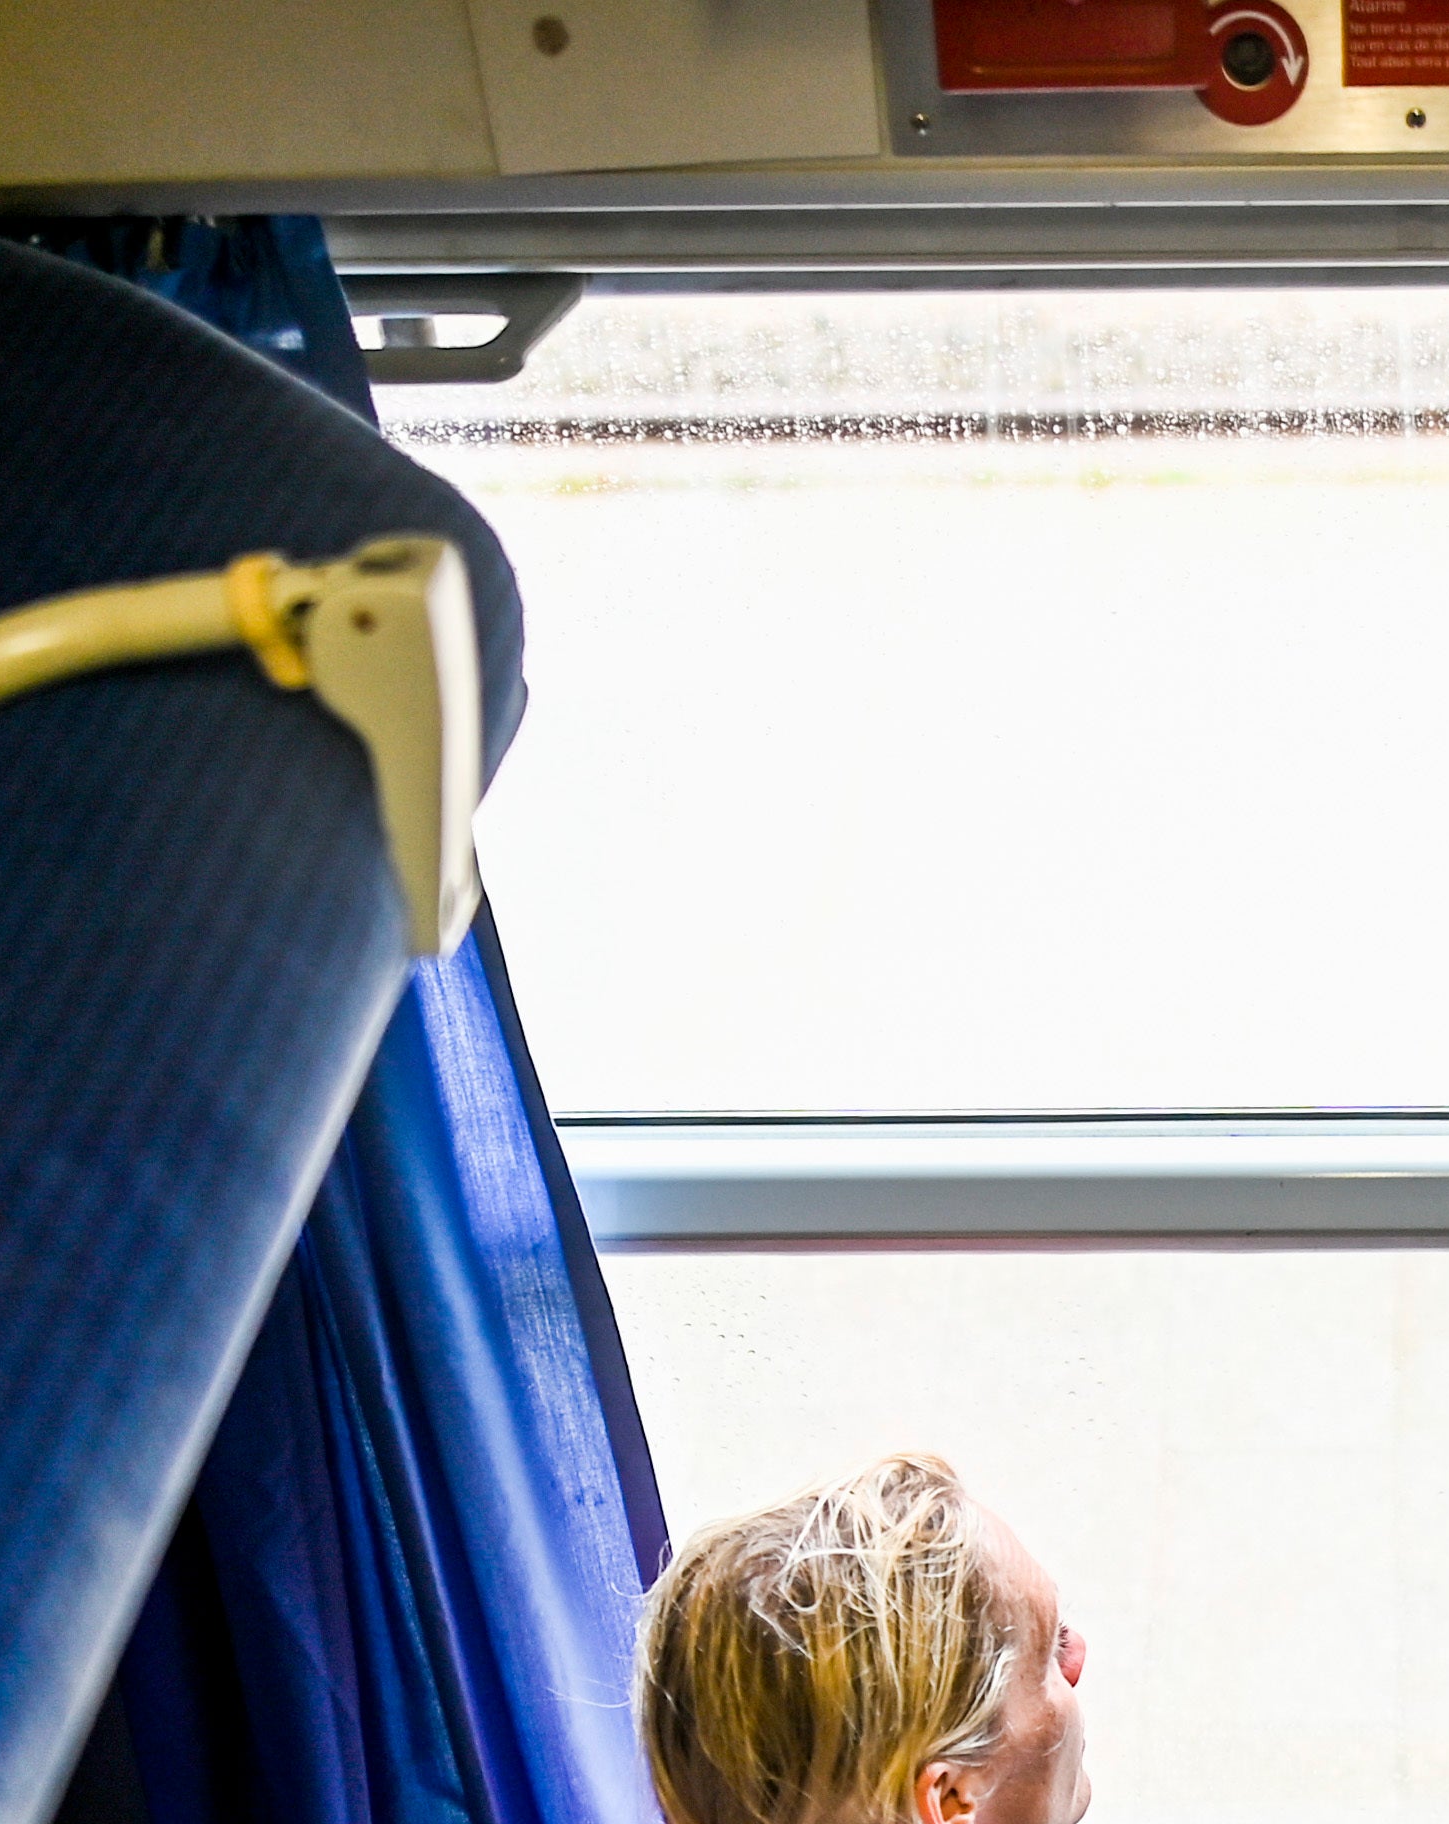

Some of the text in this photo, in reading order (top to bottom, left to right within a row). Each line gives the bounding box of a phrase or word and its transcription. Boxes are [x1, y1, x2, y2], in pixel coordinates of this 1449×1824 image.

[1350, 0, 1406, 13] Alarme
[1399, 22, 1412, 34] la
[1414, 38, 1430, 52] de
[1350, 55, 1377, 68] Tout
